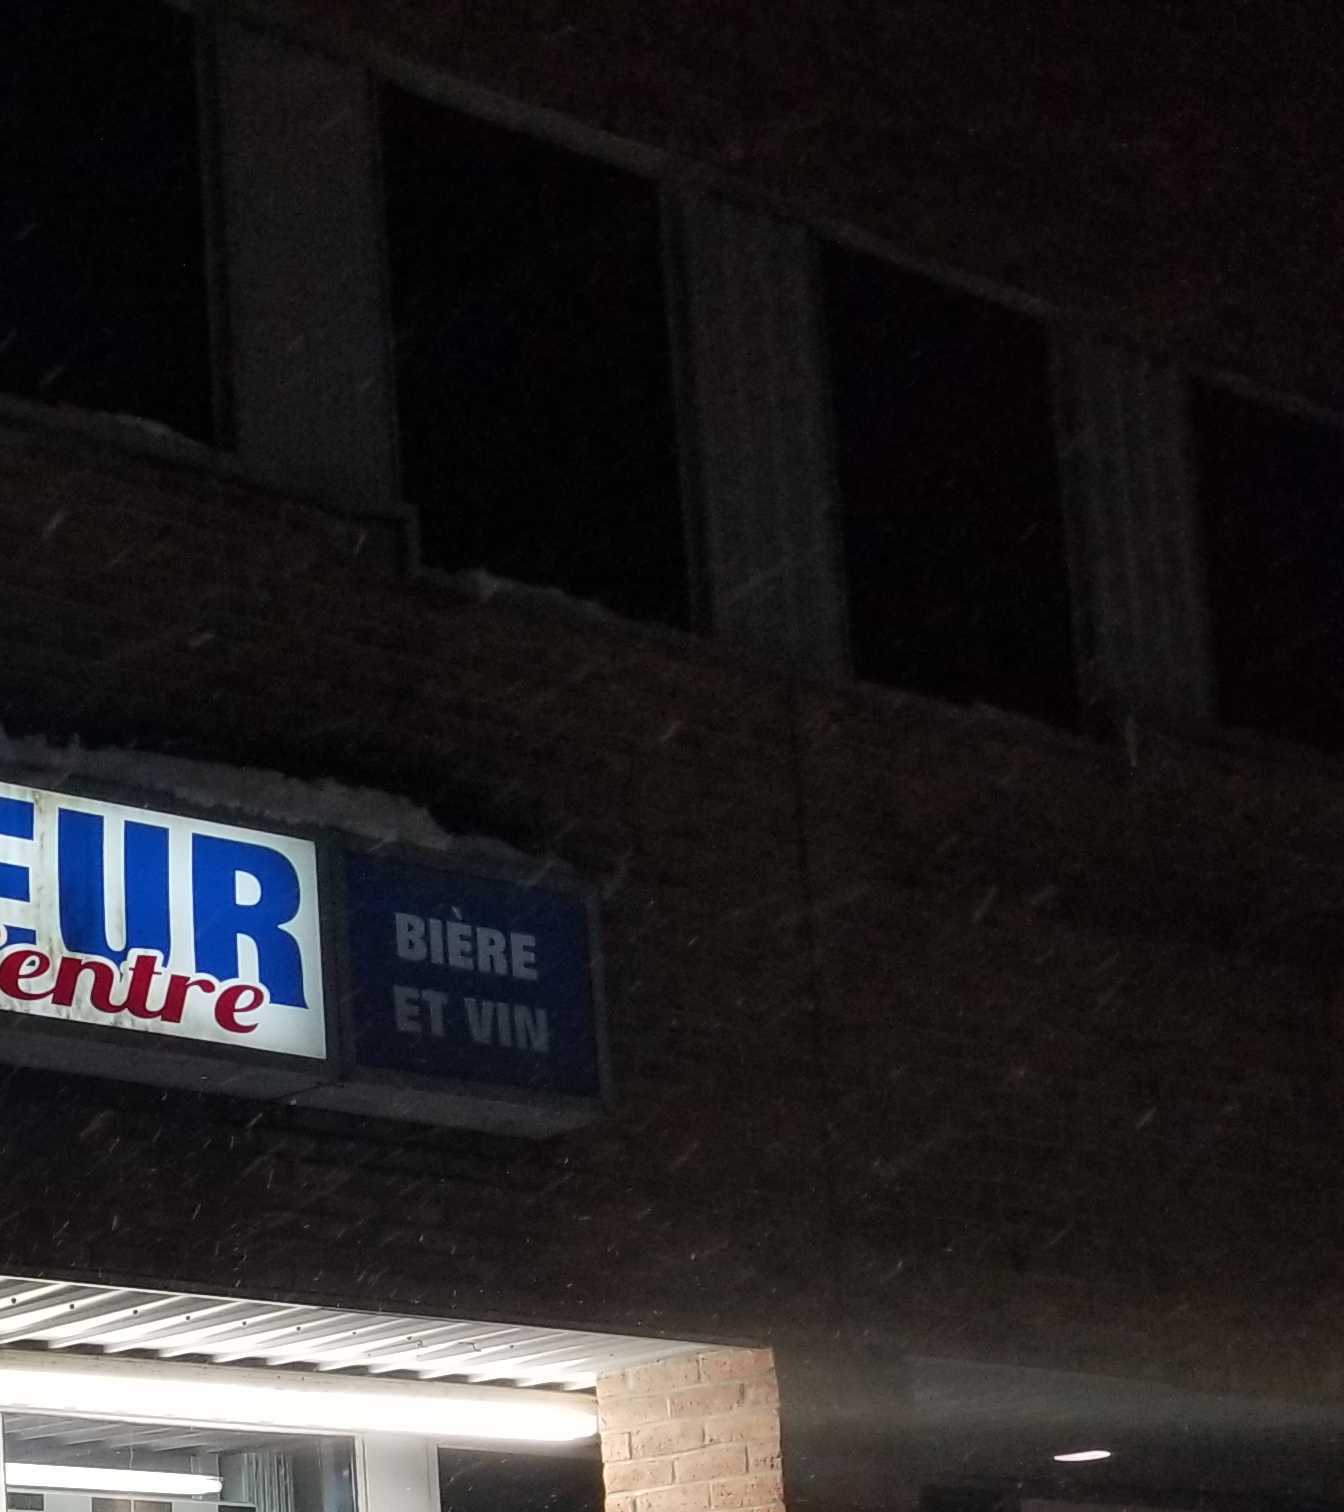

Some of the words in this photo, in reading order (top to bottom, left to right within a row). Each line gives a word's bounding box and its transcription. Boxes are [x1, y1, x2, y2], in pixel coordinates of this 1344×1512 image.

[393, 906, 538, 981] BIÈRE
[393, 985, 448, 1037] ET
[464, 997, 549, 1051] VIN
